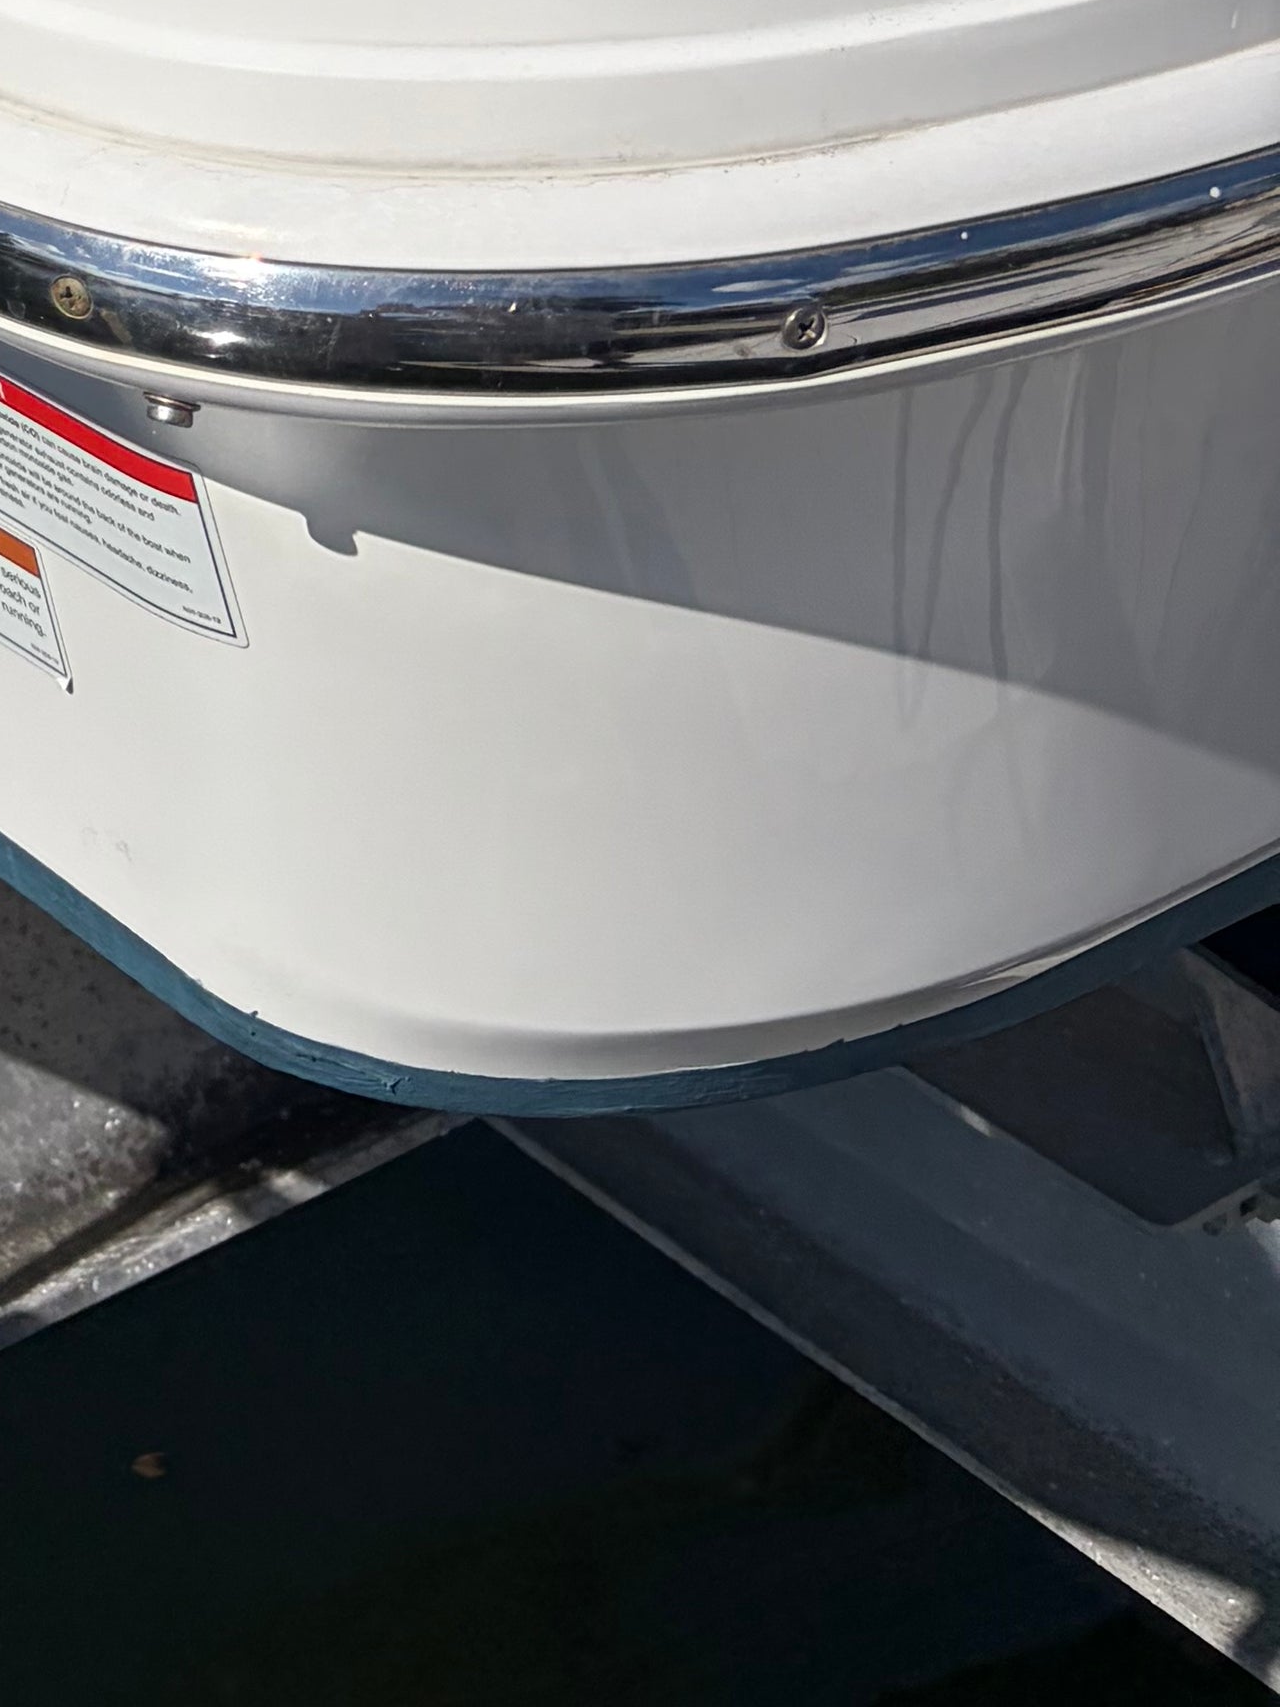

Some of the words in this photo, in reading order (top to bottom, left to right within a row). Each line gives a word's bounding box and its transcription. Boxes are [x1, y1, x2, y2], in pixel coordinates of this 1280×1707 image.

[0, 566, 41, 598] serious
[1, 601, 46, 636] running.
[28, 601, 39, 614] or
